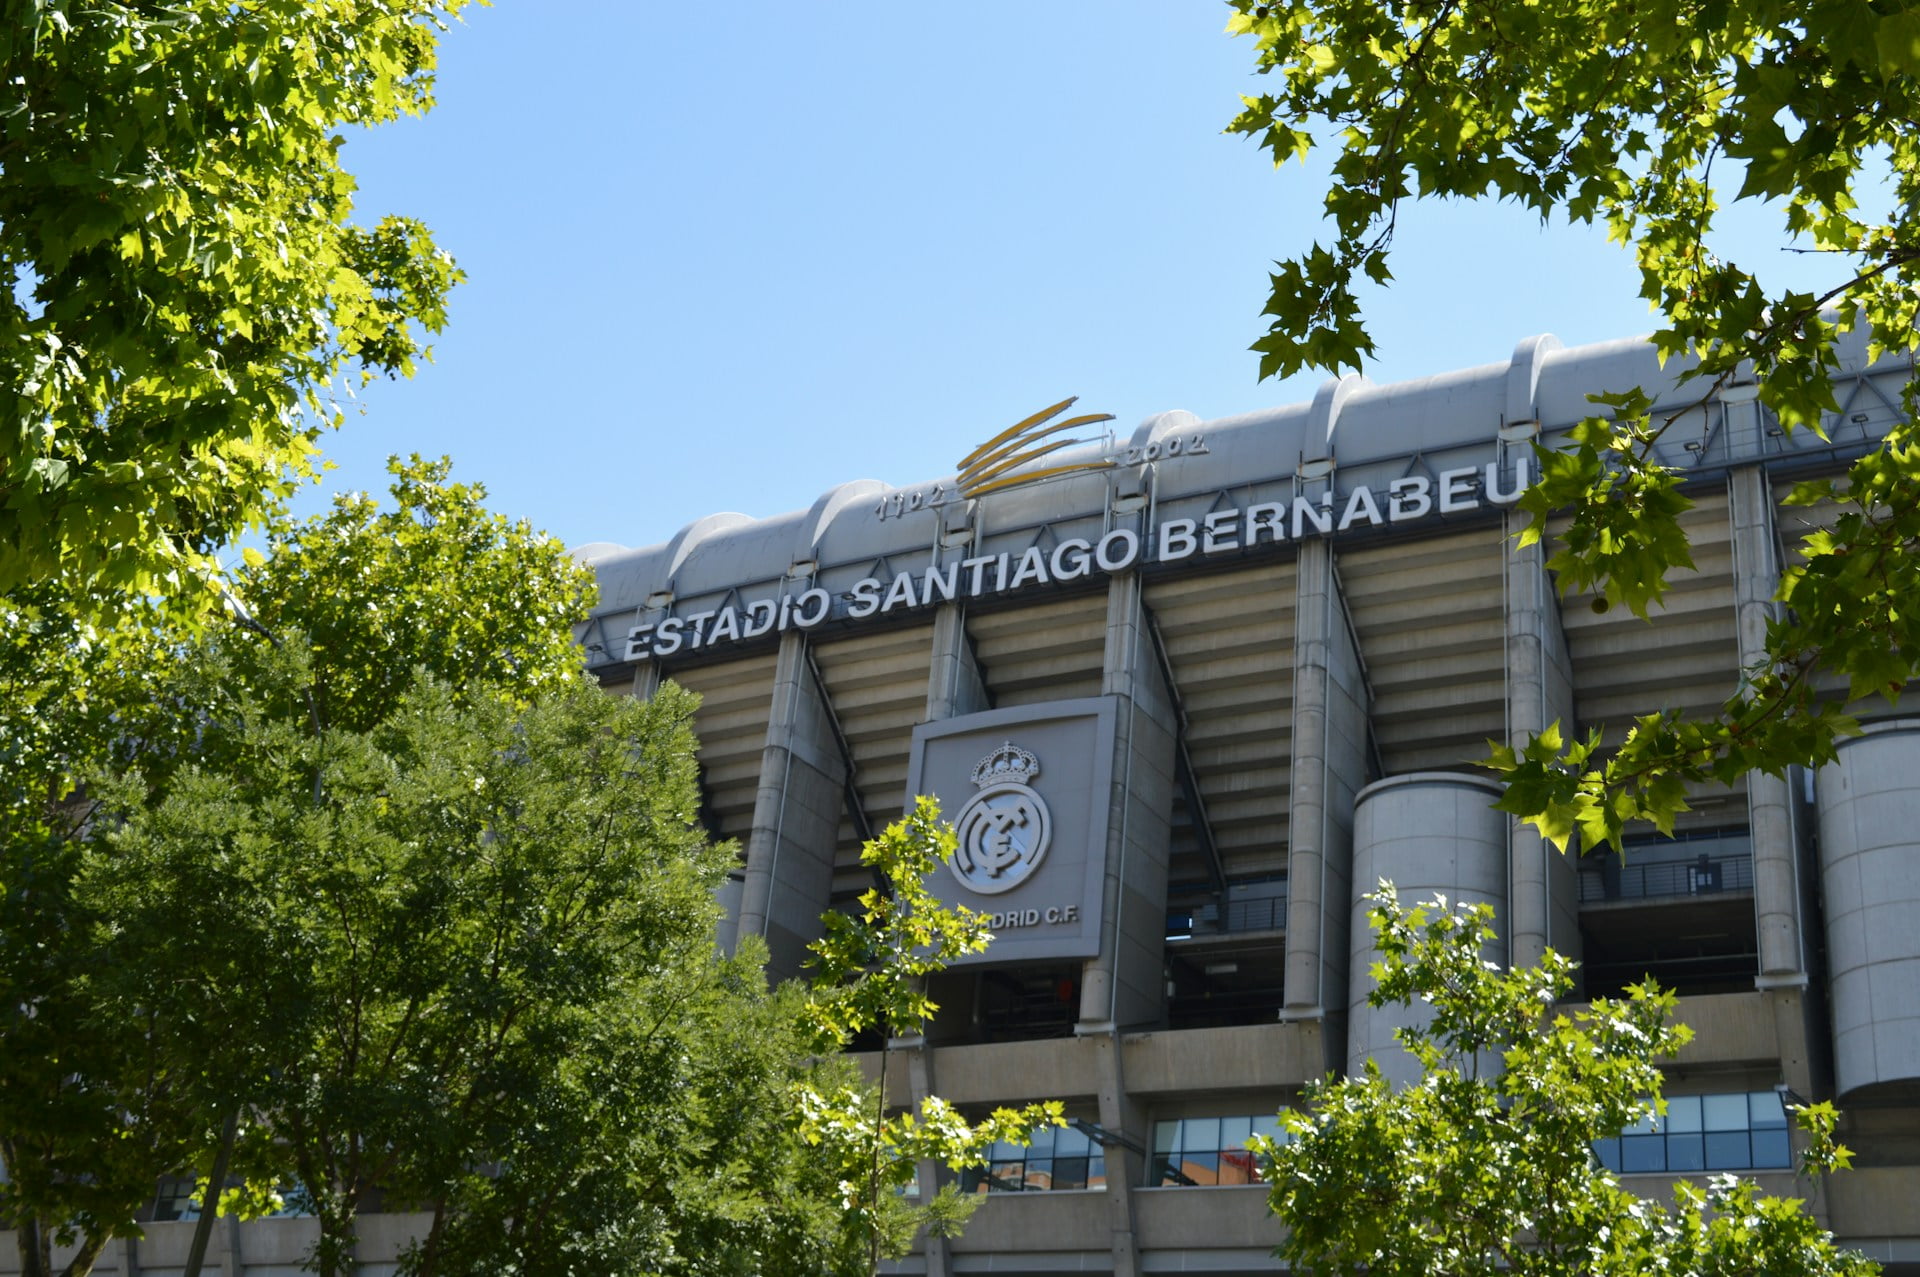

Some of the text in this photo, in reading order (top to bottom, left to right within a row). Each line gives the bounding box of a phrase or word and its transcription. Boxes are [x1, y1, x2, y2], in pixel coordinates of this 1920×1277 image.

[876, 435, 1209, 521] 1902 2002
[624, 457, 1529, 662] ESTADIO SANTIAGO BERNABEU
[962, 905, 1078, 930] DRID C.F.
